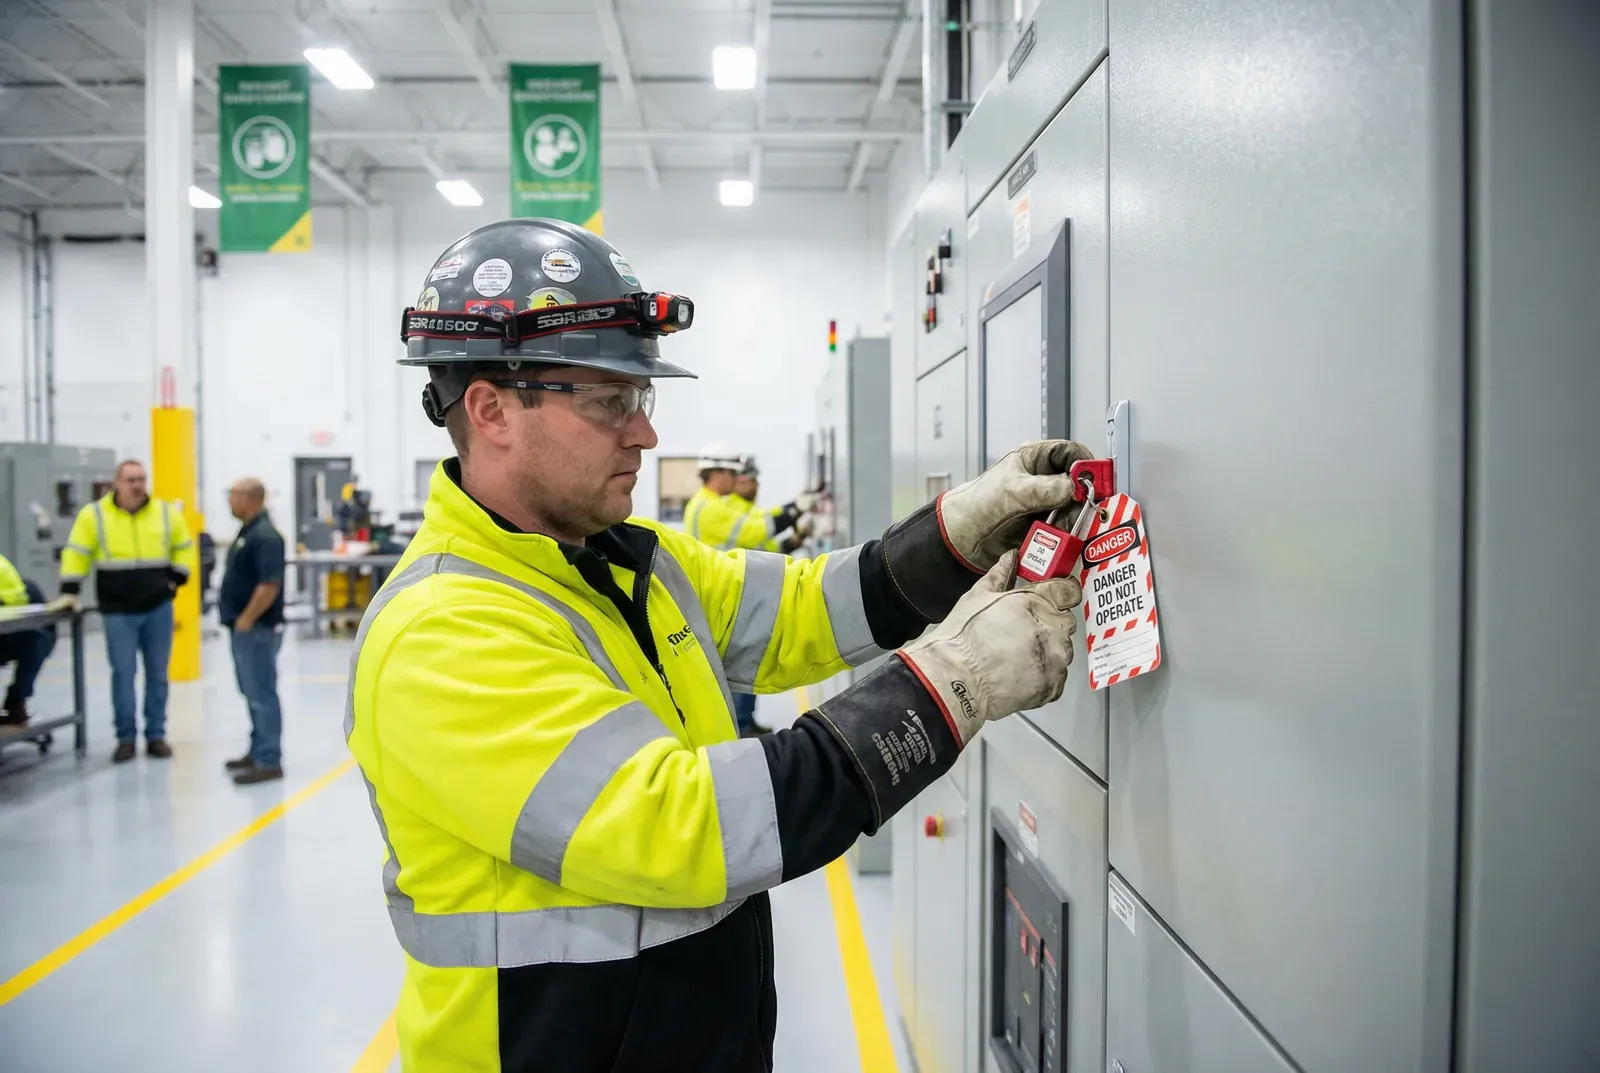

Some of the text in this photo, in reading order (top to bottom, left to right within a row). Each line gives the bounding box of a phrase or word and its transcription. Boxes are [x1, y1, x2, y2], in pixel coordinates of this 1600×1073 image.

[1088, 530, 1132, 559] DANGER
[1093, 563, 1137, 592] DANGER
[1097, 580, 1137, 608] DO NOT
[1095, 595, 1144, 626] OPERATE
